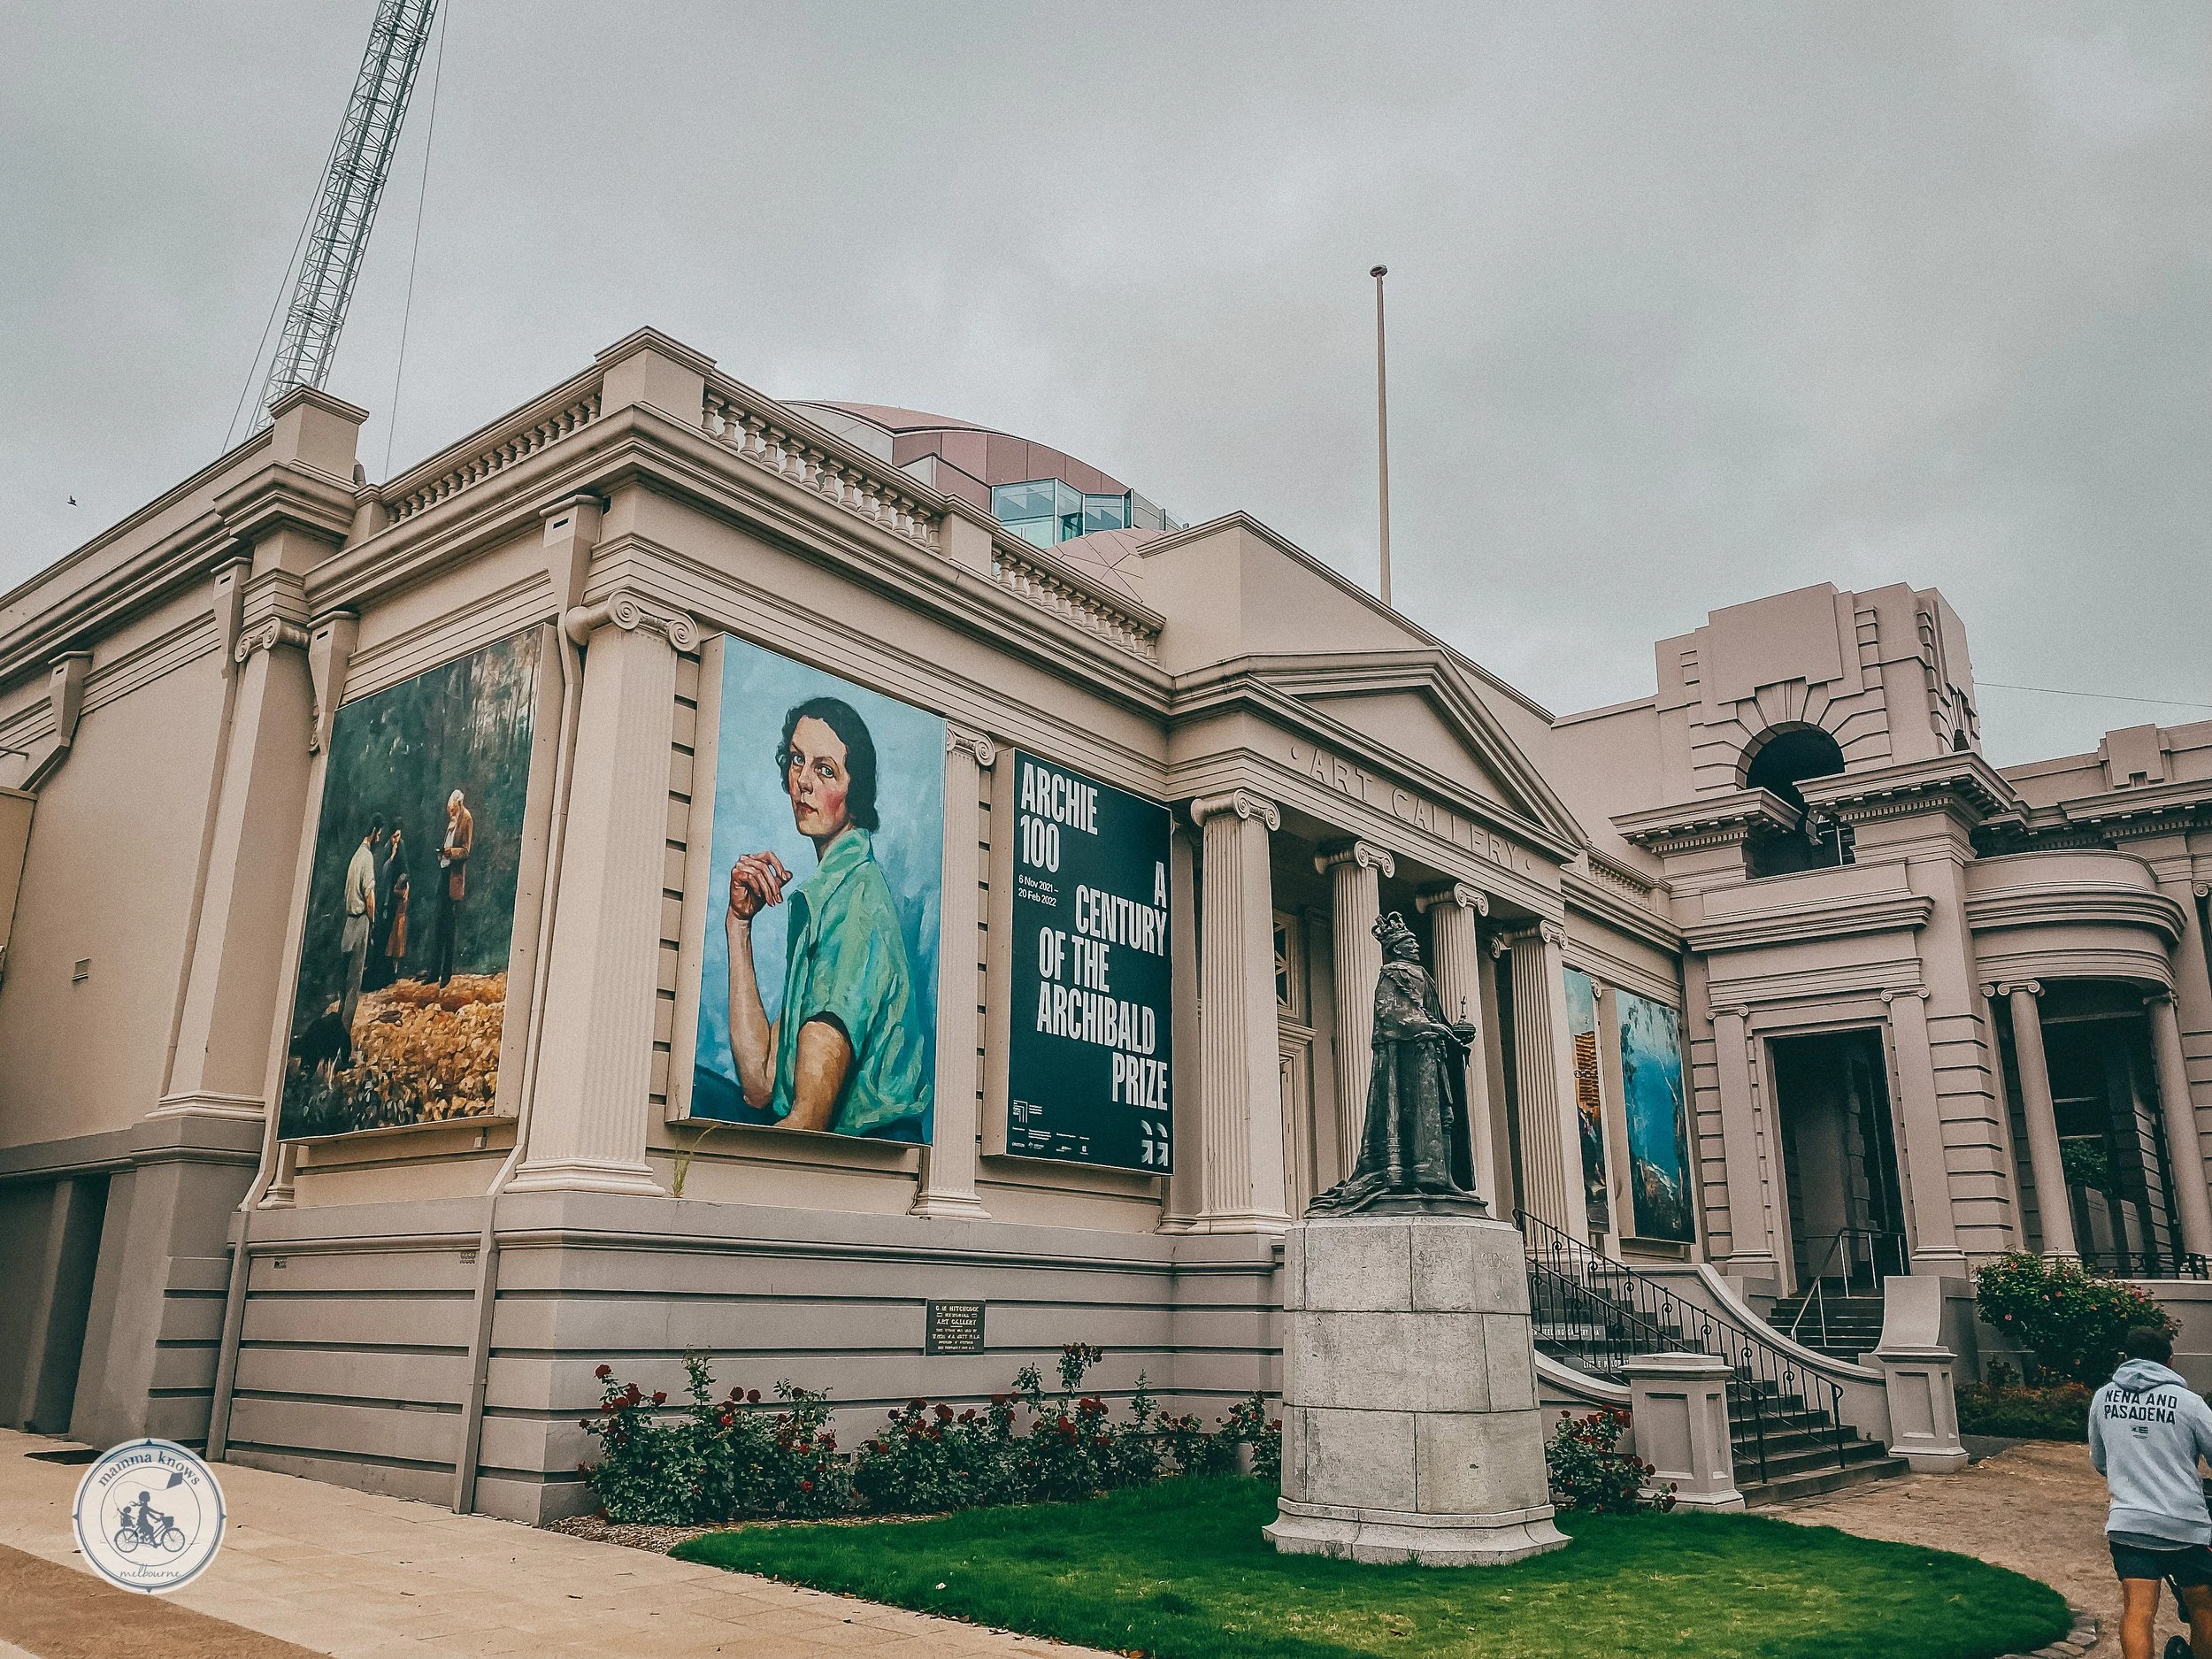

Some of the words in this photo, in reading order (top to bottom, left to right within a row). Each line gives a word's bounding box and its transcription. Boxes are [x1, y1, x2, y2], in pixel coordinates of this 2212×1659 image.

[1020, 762, 1098, 836] ARCHIE
[1310, 749, 1372, 801] ART
[1391, 787, 1519, 872] GALLERY
[1020, 814, 1060, 873] 100
[1018, 874, 1024, 884] 6
[1024, 875, 1039, 888] Nov
[1039, 880, 1053, 893] 2021
[1018, 887, 1027, 898] 20
[1027, 890, 1041, 902] Feb
[1041, 894, 1056, 907] 2022
[1154, 861, 1167, 909] A
[1075, 884, 1167, 956] CENTURY
[1039, 926, 1066, 980] OF
[1071, 934, 1110, 993] THE
[1036, 980, 1156, 1056] ARCHIBALD
[1111, 1051, 1168, 1111] PRIZE
[2104, 1389, 2140, 1405] NENA
[2146, 1393, 2177, 1409] AND
[2104, 1404, 2176, 1425] PASADENA
